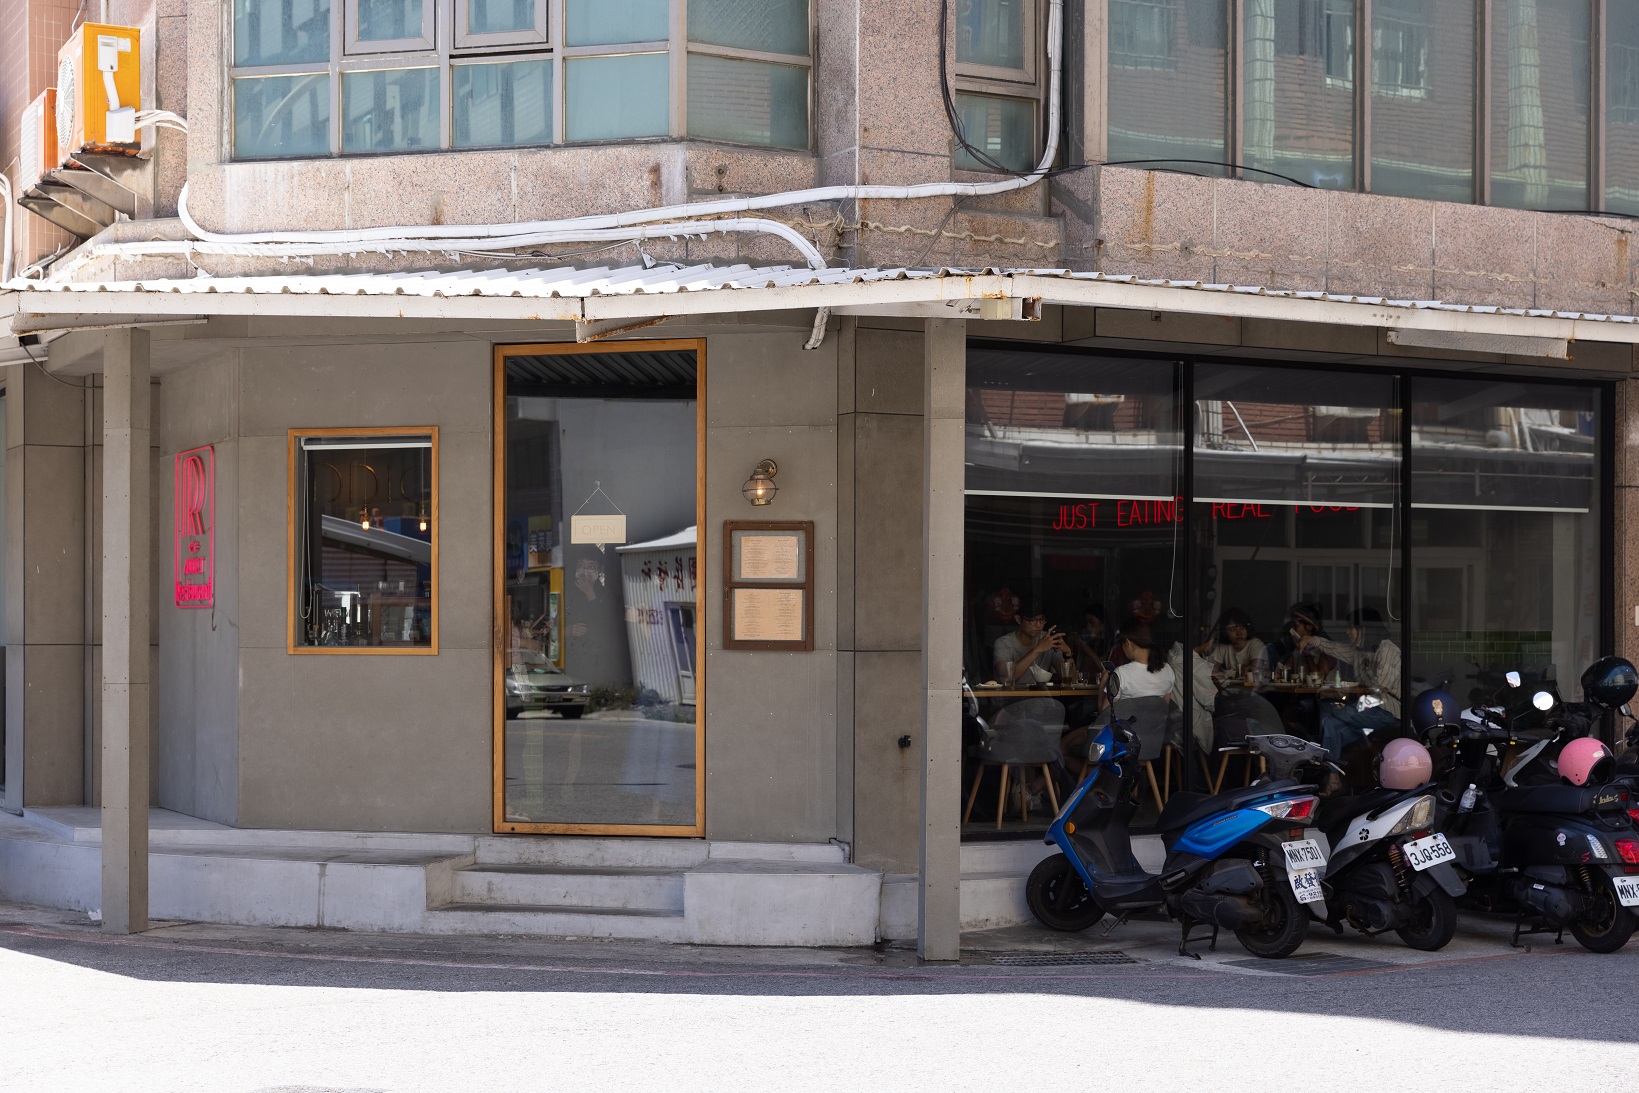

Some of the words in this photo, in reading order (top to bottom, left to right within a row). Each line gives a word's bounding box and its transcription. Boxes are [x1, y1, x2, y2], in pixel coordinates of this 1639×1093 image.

[1052, 502, 1099, 530] JUST
[1117, 496, 1184, 527] EATING
[1212, 501, 1271, 519] REAL
[582, 525, 617, 535] OPEN
[1286, 845, 1322, 863] MNX-7501
[1409, 842, 1453, 866] 3JQ-558
